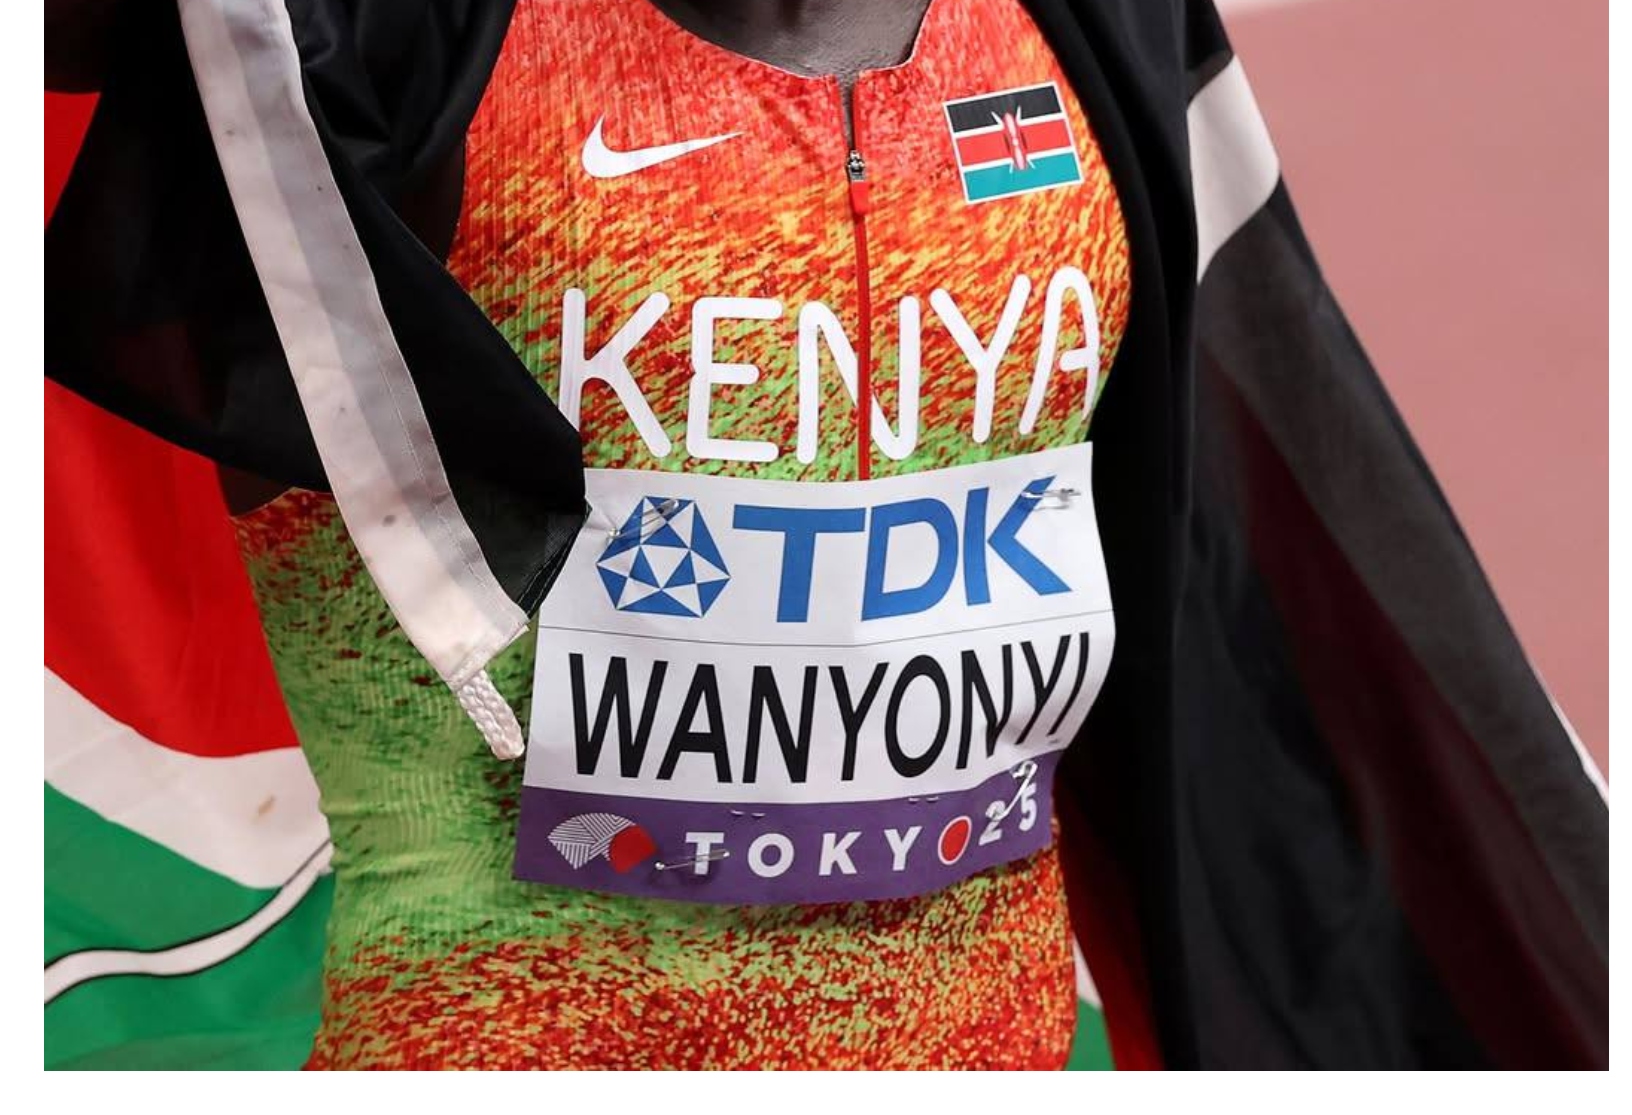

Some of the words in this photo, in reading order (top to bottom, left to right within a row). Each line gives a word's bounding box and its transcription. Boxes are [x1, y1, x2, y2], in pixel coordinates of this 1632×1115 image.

[559, 266, 1101, 464] KENYA
[733, 474, 1073, 623] TDK
[568, 631, 1090, 784] WANYONYI
